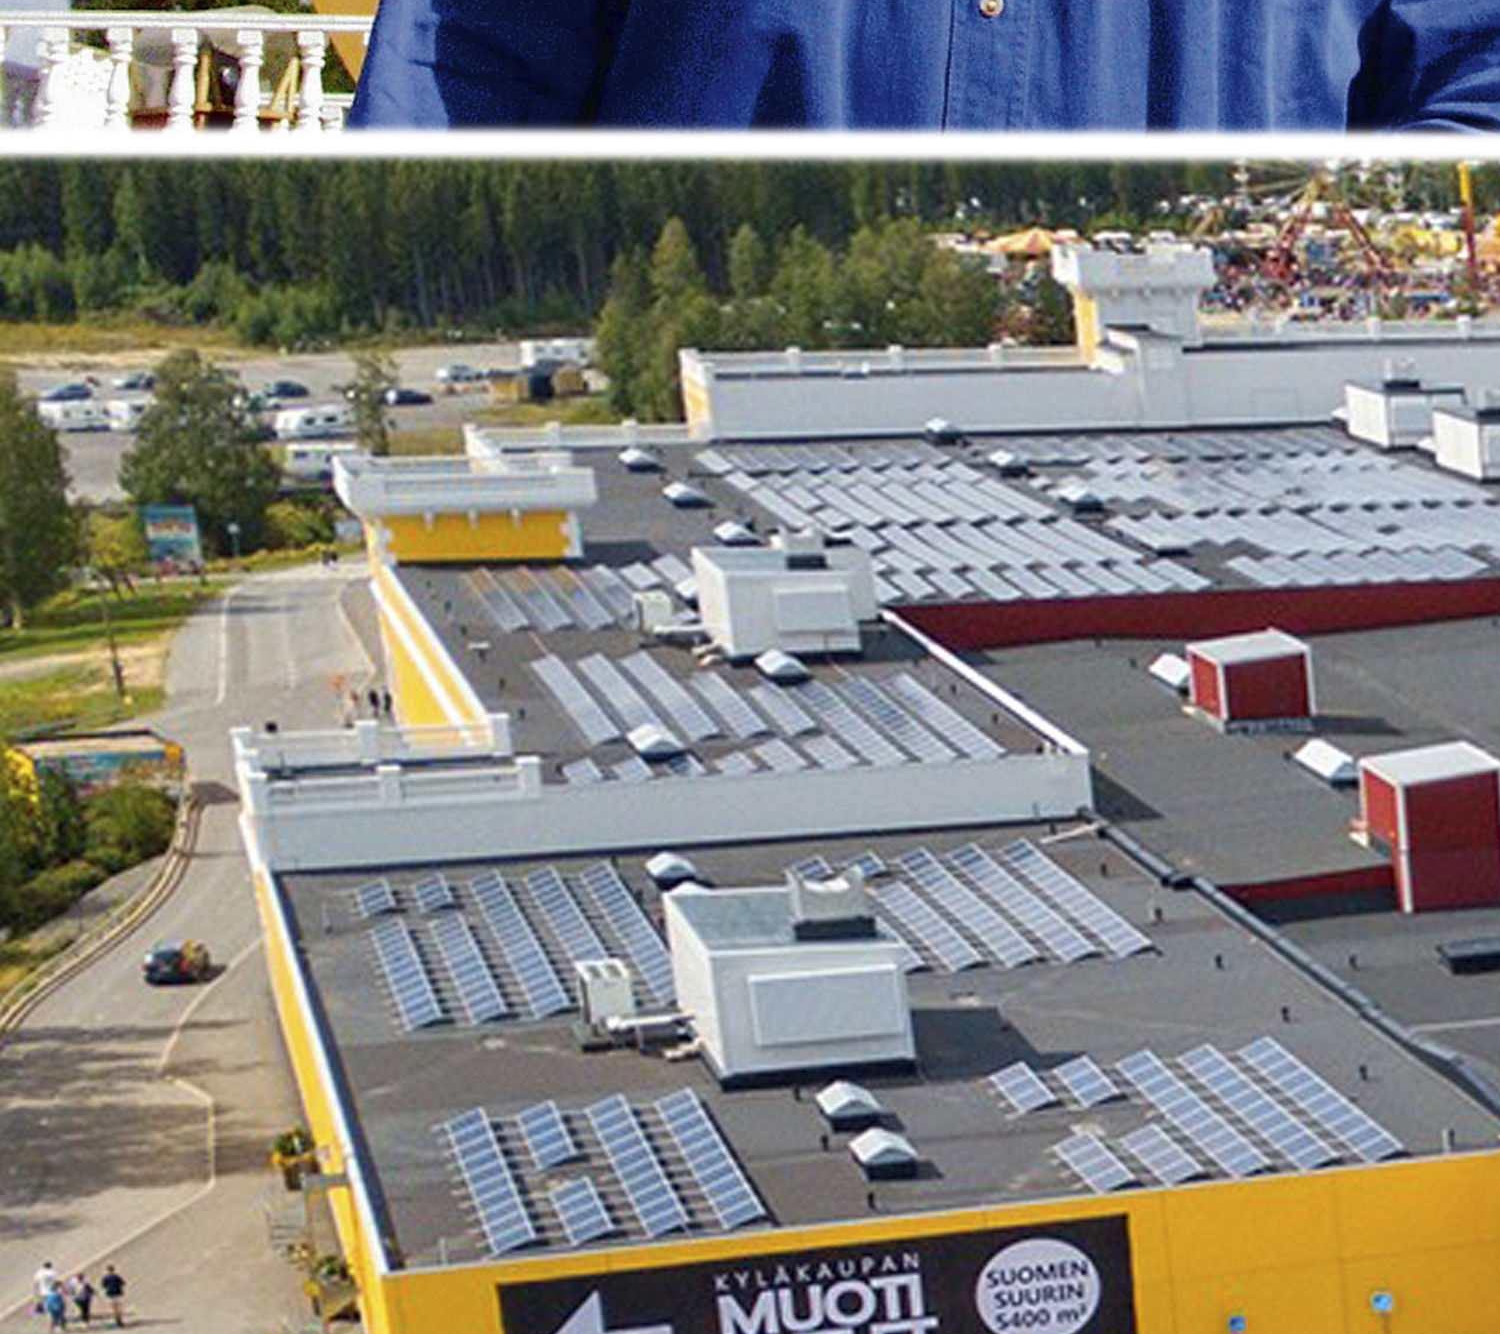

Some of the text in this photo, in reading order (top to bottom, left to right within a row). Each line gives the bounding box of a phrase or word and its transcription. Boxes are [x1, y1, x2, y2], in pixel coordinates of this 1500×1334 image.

[986, 1260, 1088, 1289] SUOMEN
[994, 1283, 1084, 1308] SUURIN
[996, 1308, 1051, 1330] 5400
